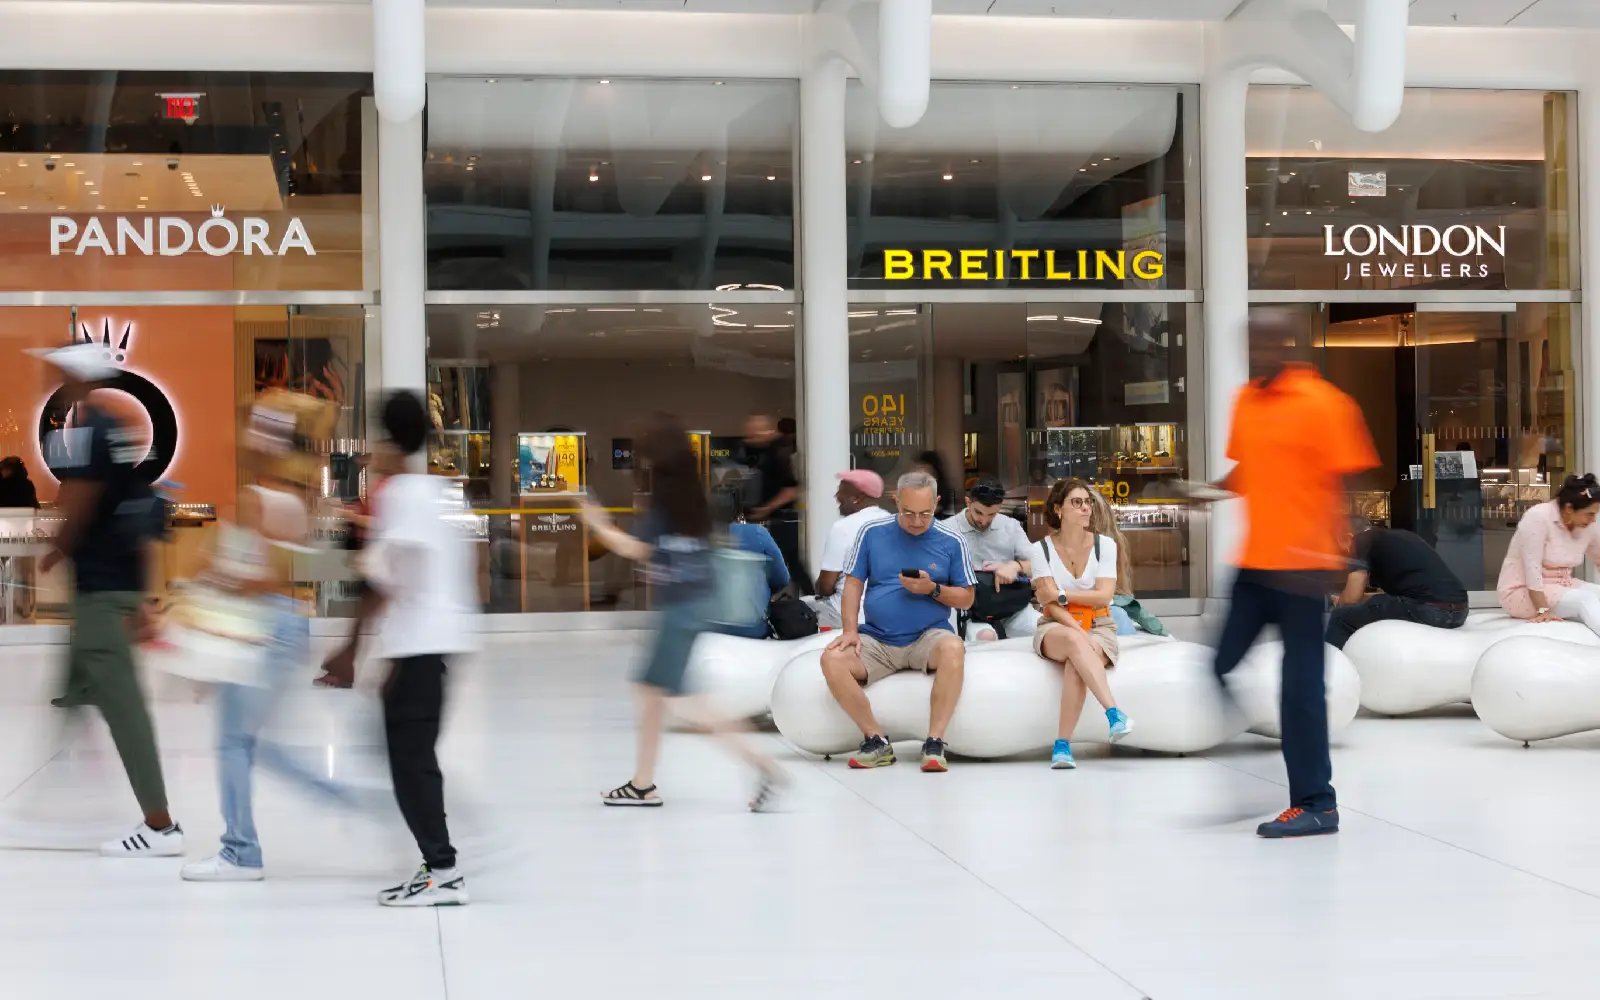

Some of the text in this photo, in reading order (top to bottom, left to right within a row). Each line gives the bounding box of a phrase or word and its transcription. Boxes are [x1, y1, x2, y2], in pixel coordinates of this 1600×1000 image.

[50, 216, 316, 256] PANDORA
[1324, 224, 1506, 257] LONDON
[883, 249, 1165, 281] BREITLING
[1344, 262, 1489, 280] JEWELERS
